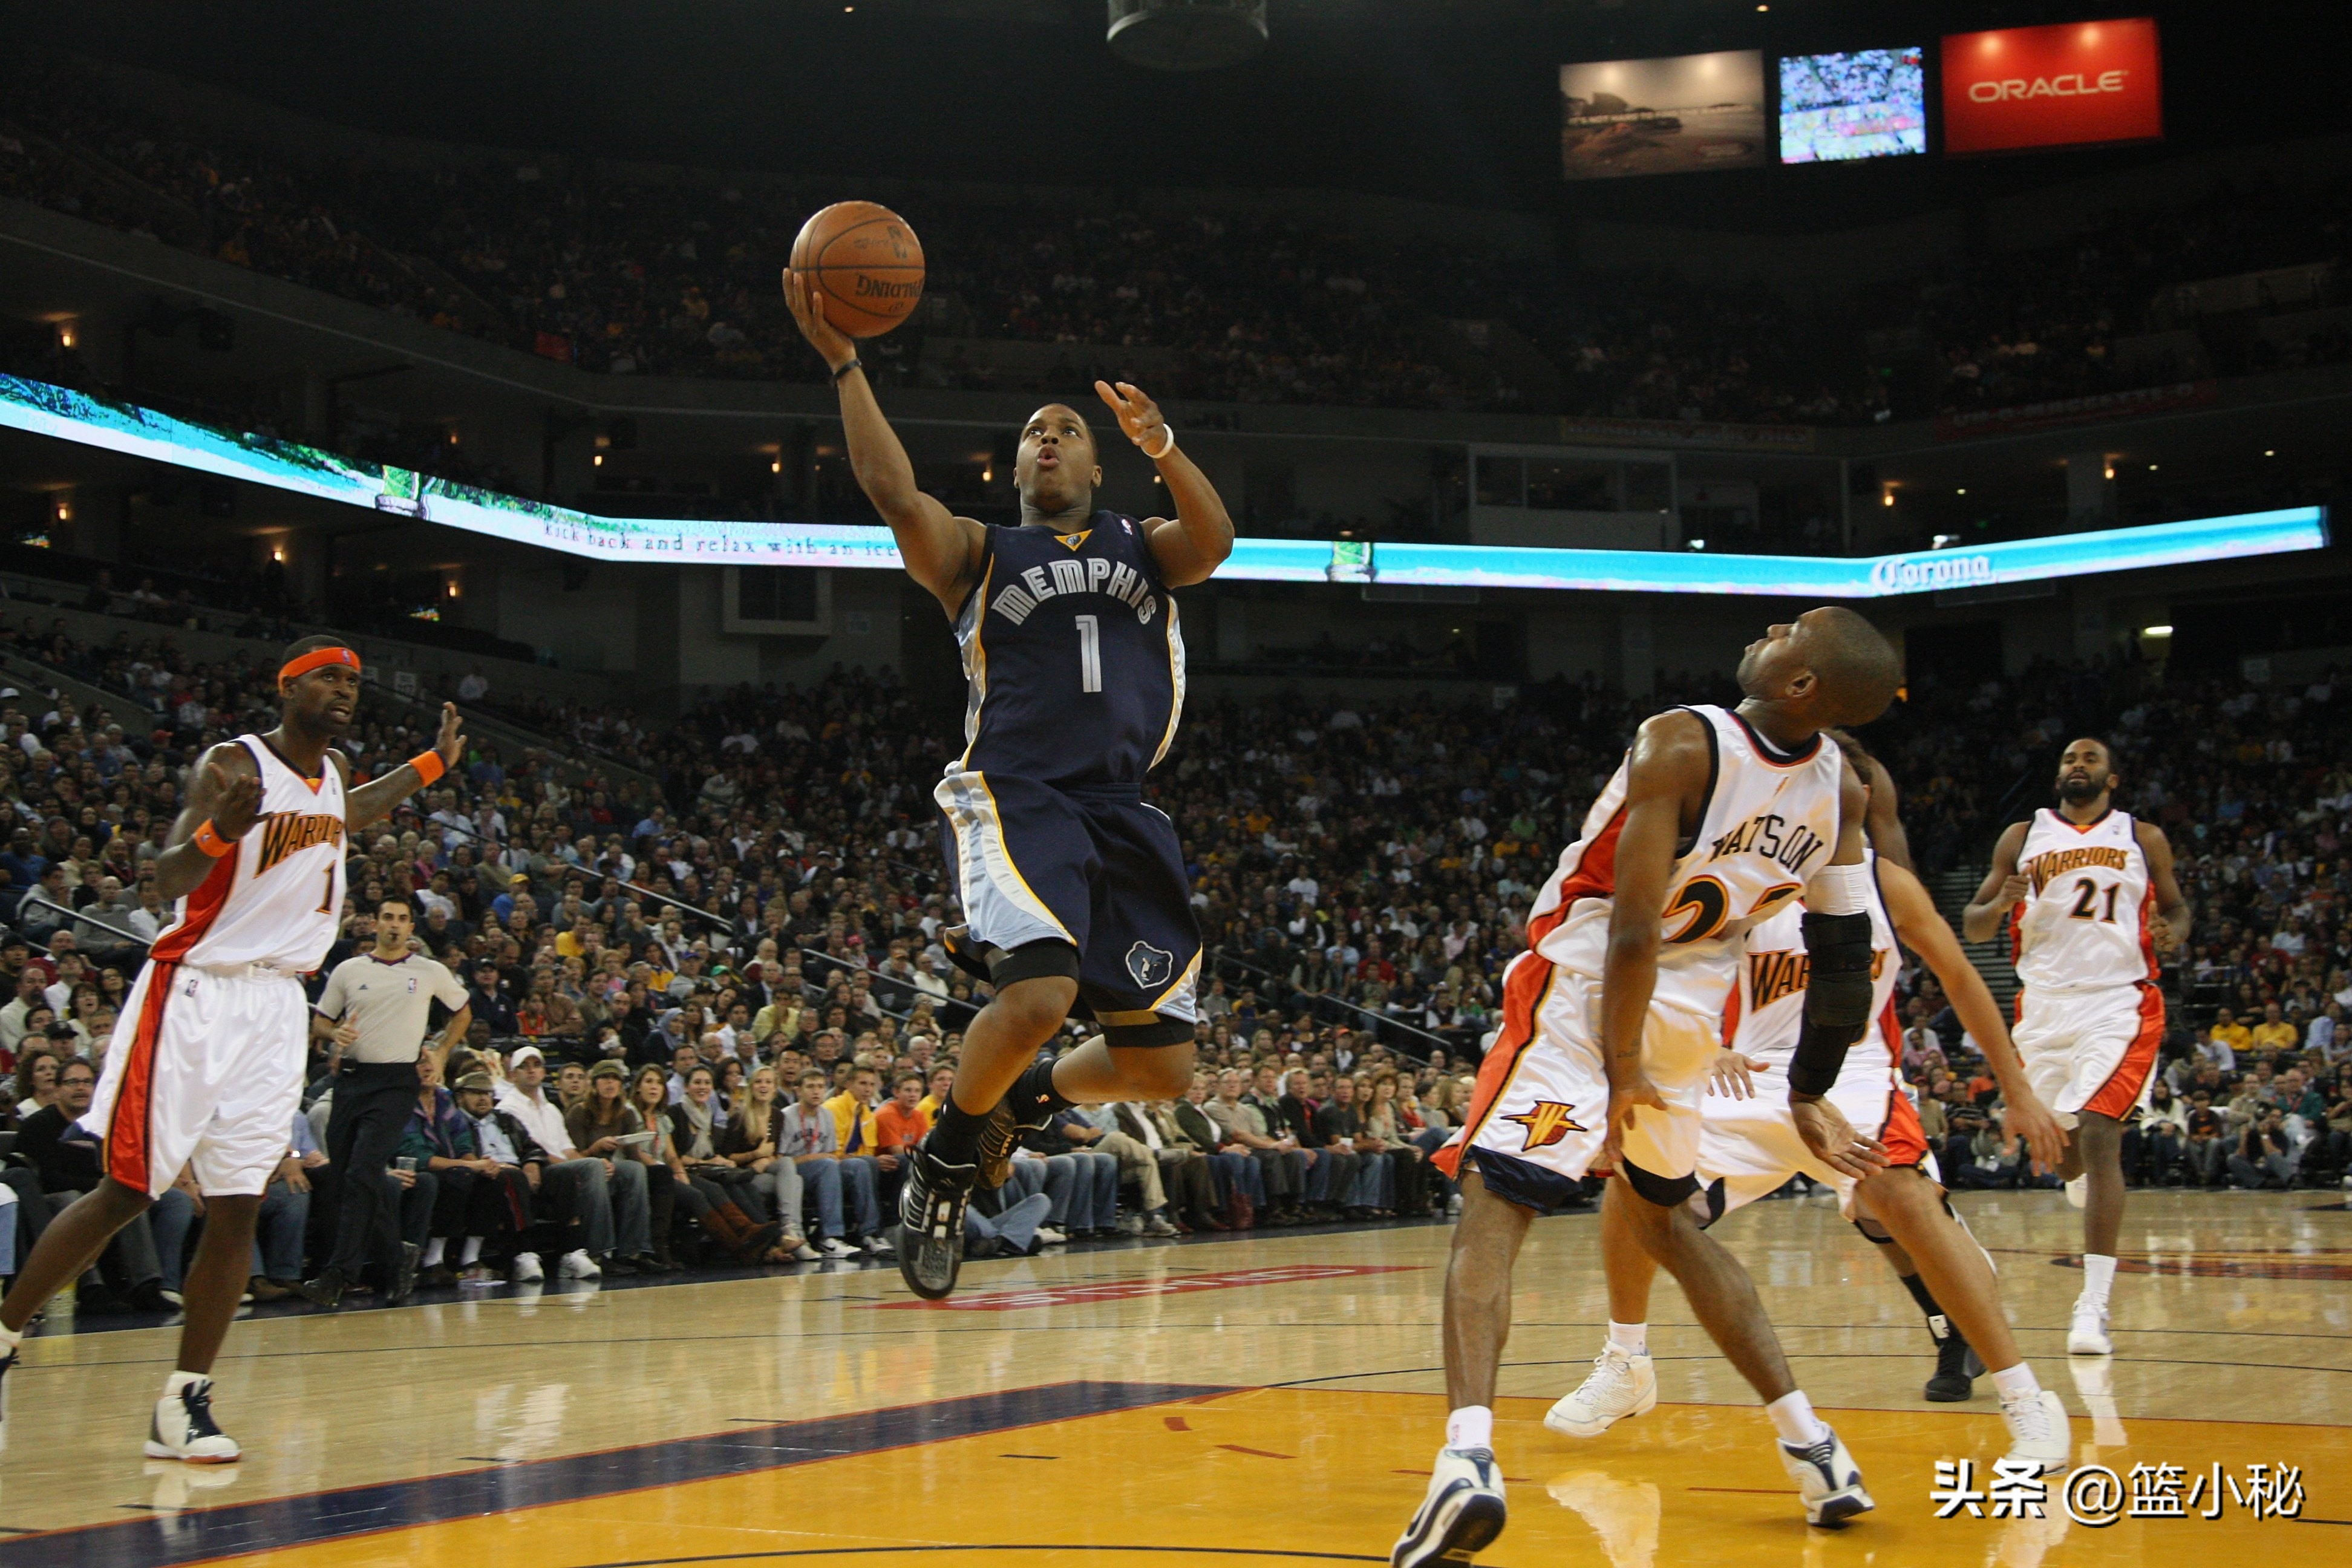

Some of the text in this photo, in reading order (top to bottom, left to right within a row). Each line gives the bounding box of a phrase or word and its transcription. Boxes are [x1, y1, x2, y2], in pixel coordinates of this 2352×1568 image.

[1968, 70, 2125, 103] ORACLE
[546, 523, 579, 541] kick
[587, 525, 633, 549] back
[645, 533, 684, 551] and
[696, 534, 755, 553] relax
[768, 536, 818, 554] with
[829, 544, 854, 555] an
[990, 557, 1157, 626] MEMPHIS
[1870, 555, 1994, 595] Corona
[1075, 615, 1102, 693] 1
[315, 859, 337, 915] 1
[2024, 846, 2129, 901] WARRIORS
[2068, 877, 2121, 924] 21
